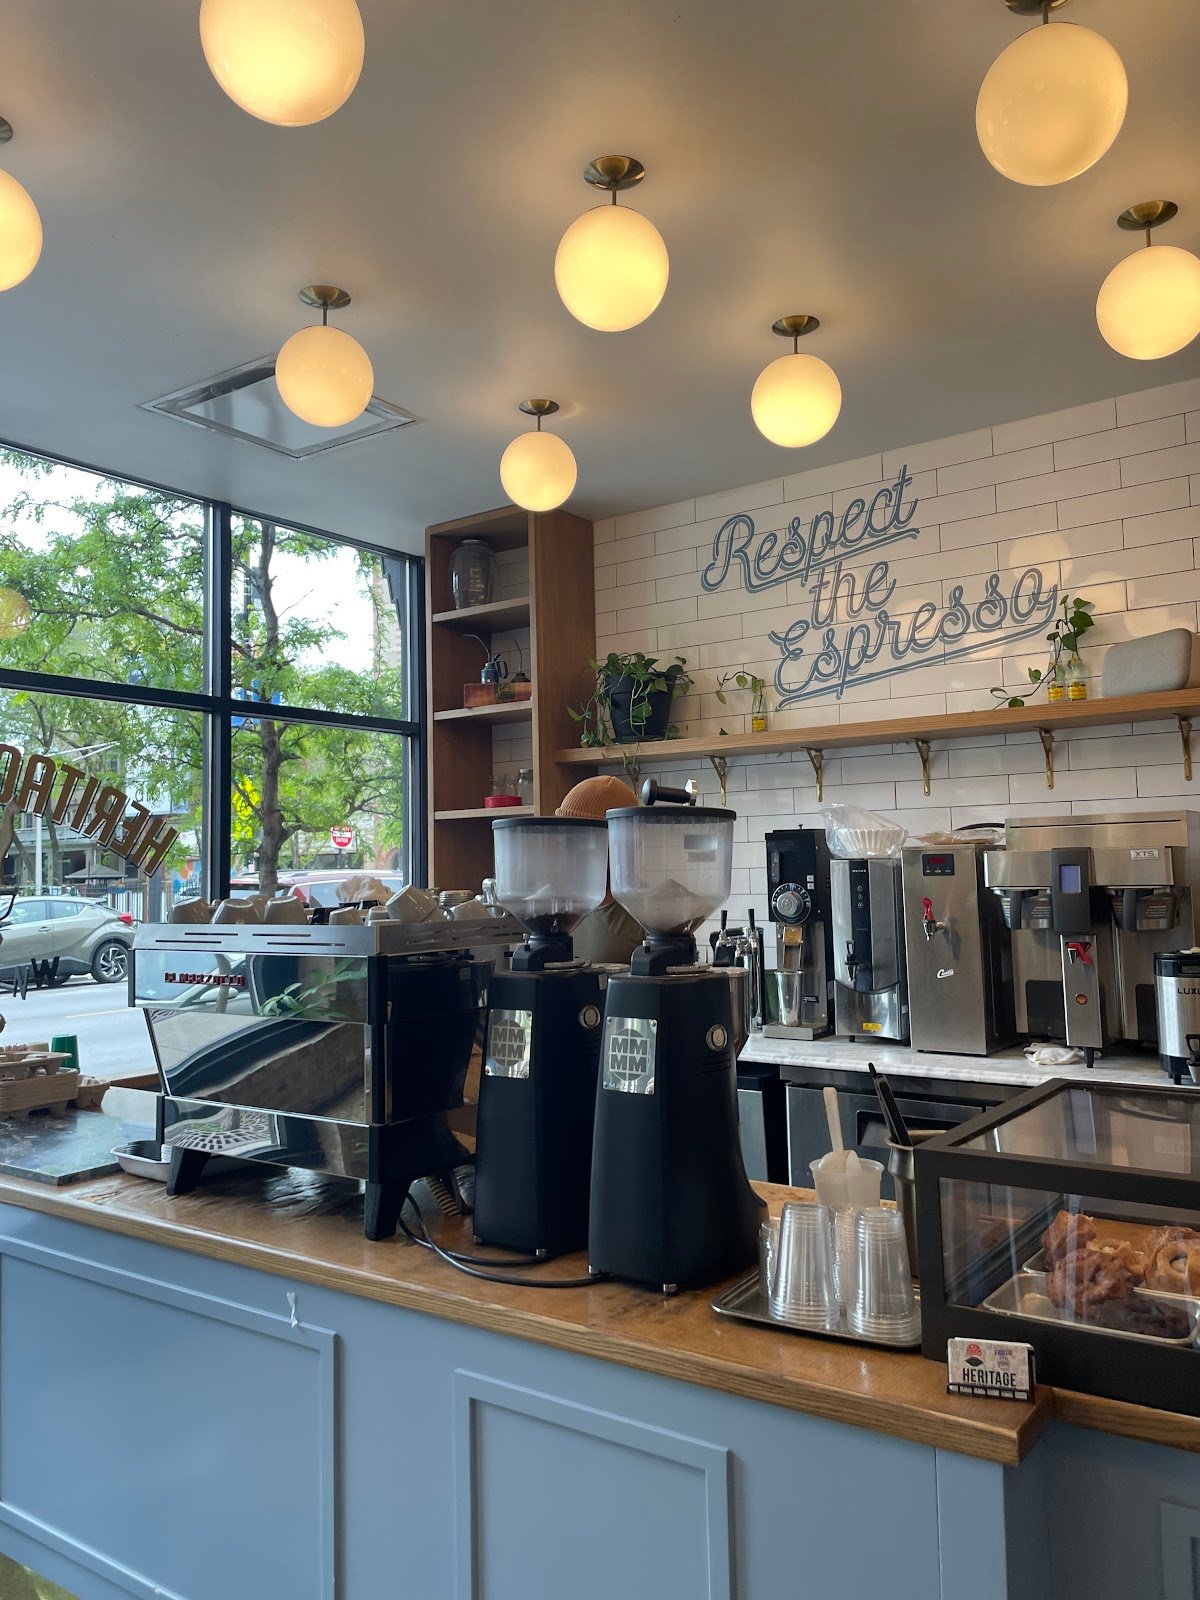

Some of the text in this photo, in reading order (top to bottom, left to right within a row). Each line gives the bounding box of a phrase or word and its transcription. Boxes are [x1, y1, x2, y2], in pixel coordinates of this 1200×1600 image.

[701, 465, 920, 593] Respect
[768, 568, 1058, 712] Espresso
[809, 560, 897, 630] the
[962, 1367, 1017, 1387] HERITAGE
